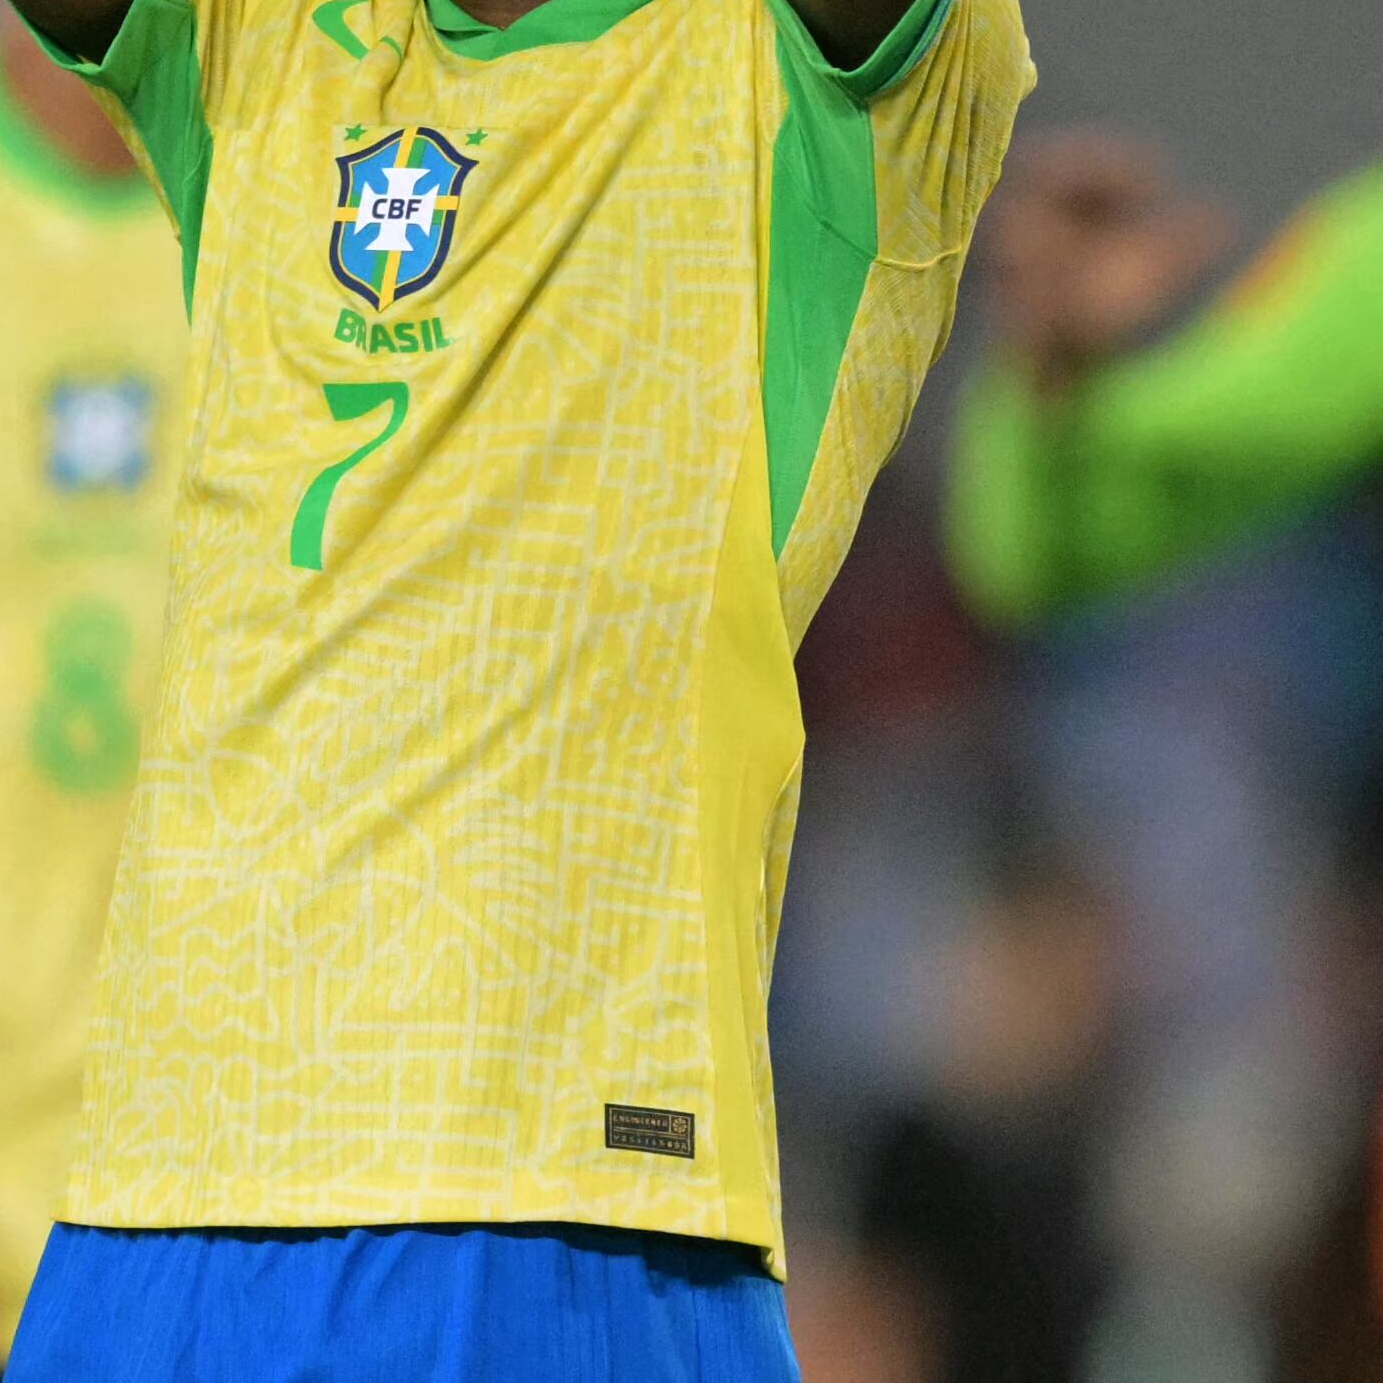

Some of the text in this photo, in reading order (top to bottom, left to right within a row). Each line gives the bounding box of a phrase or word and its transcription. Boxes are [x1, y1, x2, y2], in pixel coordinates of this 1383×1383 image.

[372, 198, 422, 219] CBF
[334, 308, 452, 354] BRASIL
[290, 381, 410, 572] 7
[32, 595, 141, 793] 8
